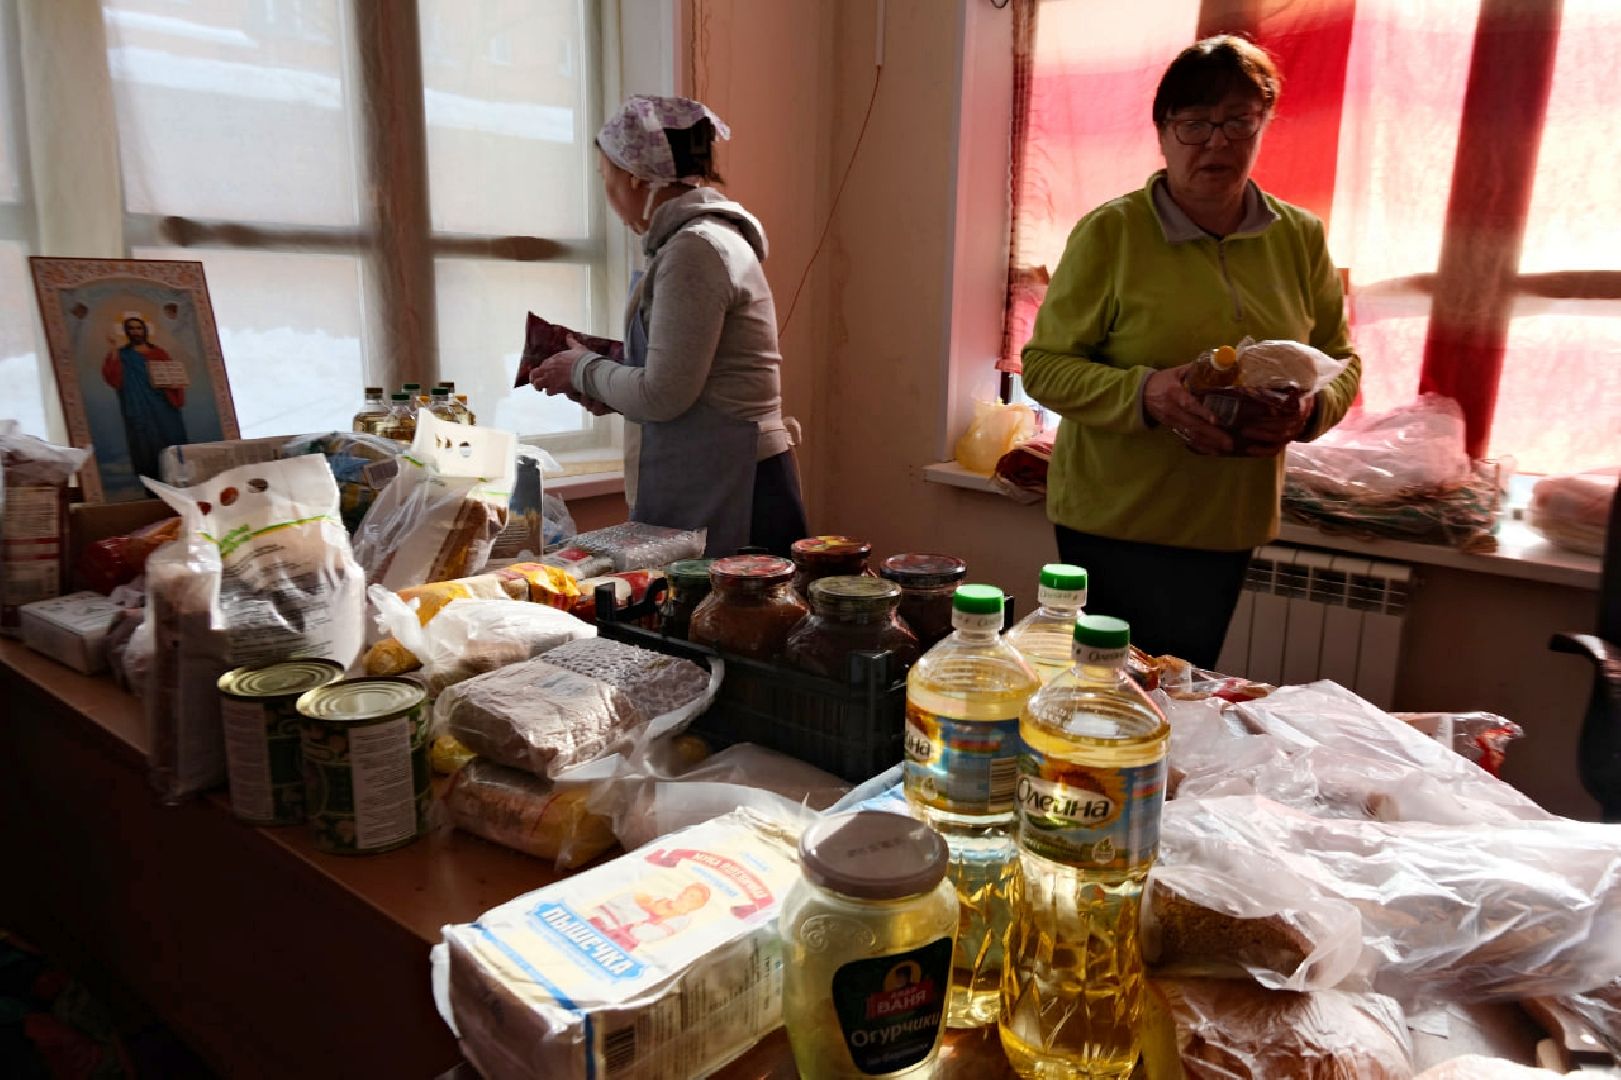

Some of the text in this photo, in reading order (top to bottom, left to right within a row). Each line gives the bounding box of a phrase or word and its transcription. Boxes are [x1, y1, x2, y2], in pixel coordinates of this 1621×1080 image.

[1018, 777, 1110, 818] Олейна
[877, 990, 927, 1014] ВАНЯ
[851, 1011, 941, 1048] Огурчики
